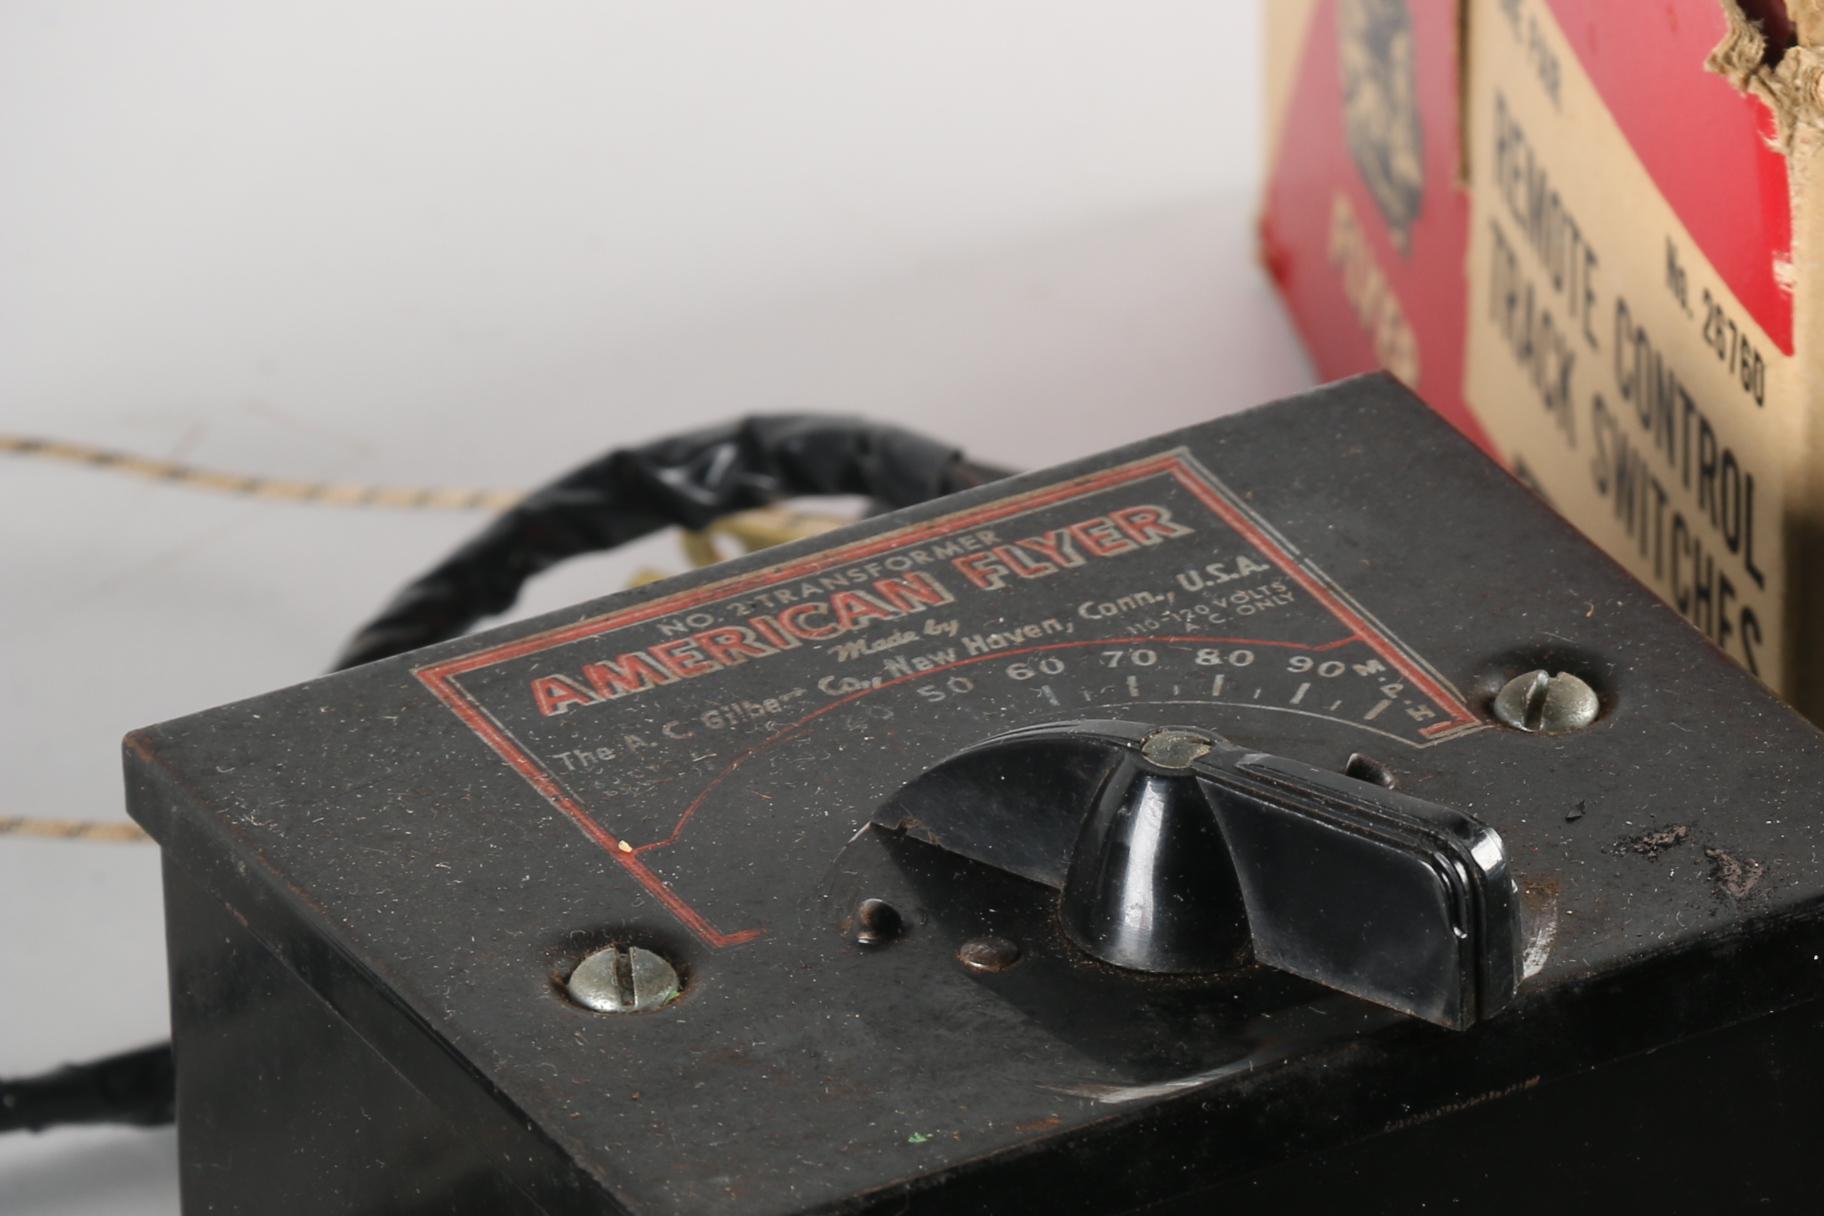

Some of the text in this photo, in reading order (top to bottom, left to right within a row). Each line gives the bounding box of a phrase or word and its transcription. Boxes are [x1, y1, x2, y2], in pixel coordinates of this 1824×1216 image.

[1493, 87, 1598, 352] REMOTE
[1614, 295, 1766, 592] CONTROL
[1702, 288, 1766, 407] 26760
[1489, 215, 1578, 450] TRACK
[1590, 393, 1763, 678] SWITCHES
[531, 504, 1196, 717] AMERICAN FLYER
[656, 612, 725, 637] NO.
[1213, 580, 1288, 609] VOLTS
[1236, 591, 1296, 616] ONLY
[552, 745, 617, 772] The
[1078, 590, 1176, 620] Conn.,
[1175, 555, 1271, 592] U.S.A.
[828, 617, 960, 663] Made by
[916, 676, 974, 703] 50
[1006, 656, 1065, 681] 60
[1101, 648, 1158, 669] 70
[1195, 648, 1256, 668] 80
[1286, 654, 1346, 678] 90
